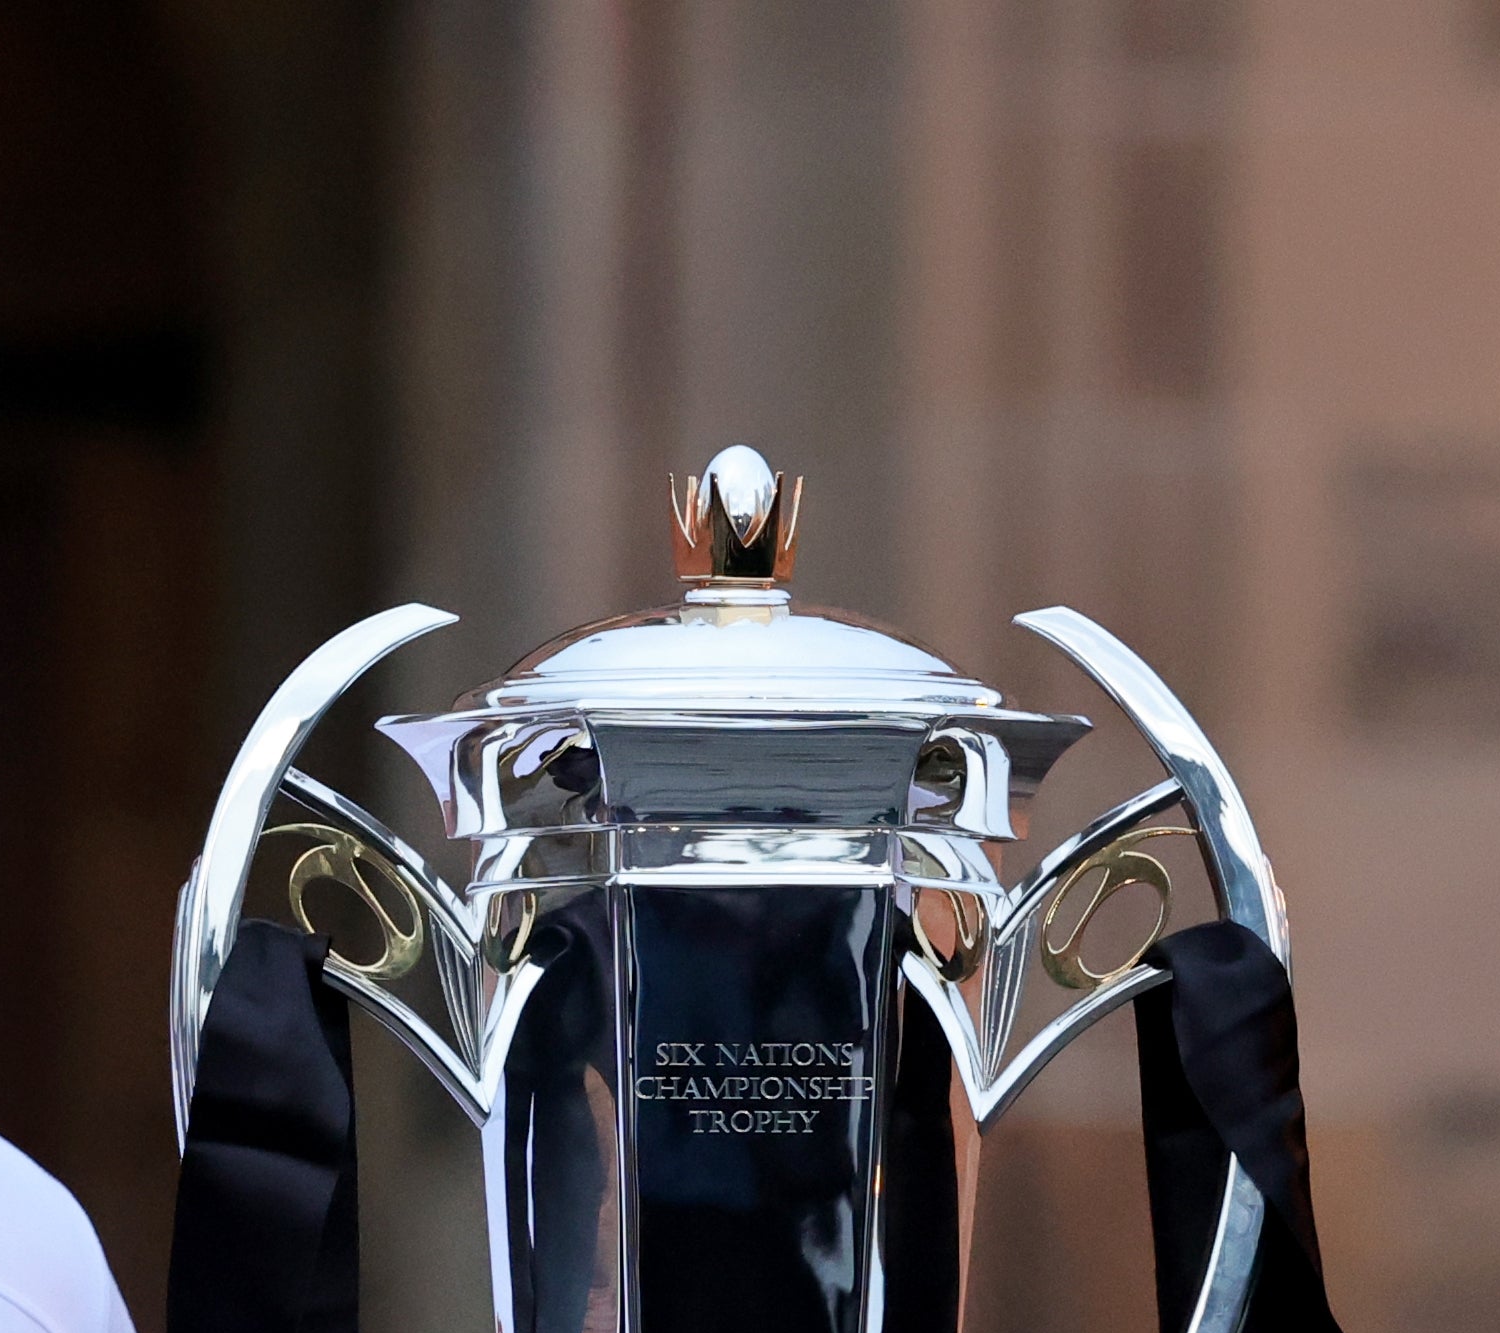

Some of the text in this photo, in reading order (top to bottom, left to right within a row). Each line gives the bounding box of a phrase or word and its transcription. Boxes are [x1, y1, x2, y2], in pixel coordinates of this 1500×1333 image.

[655, 1043, 854, 1067] SIX NATIONS
[634, 1077, 875, 1100] CHAMPIONSHIP
[689, 1110, 820, 1133] TROPHY
